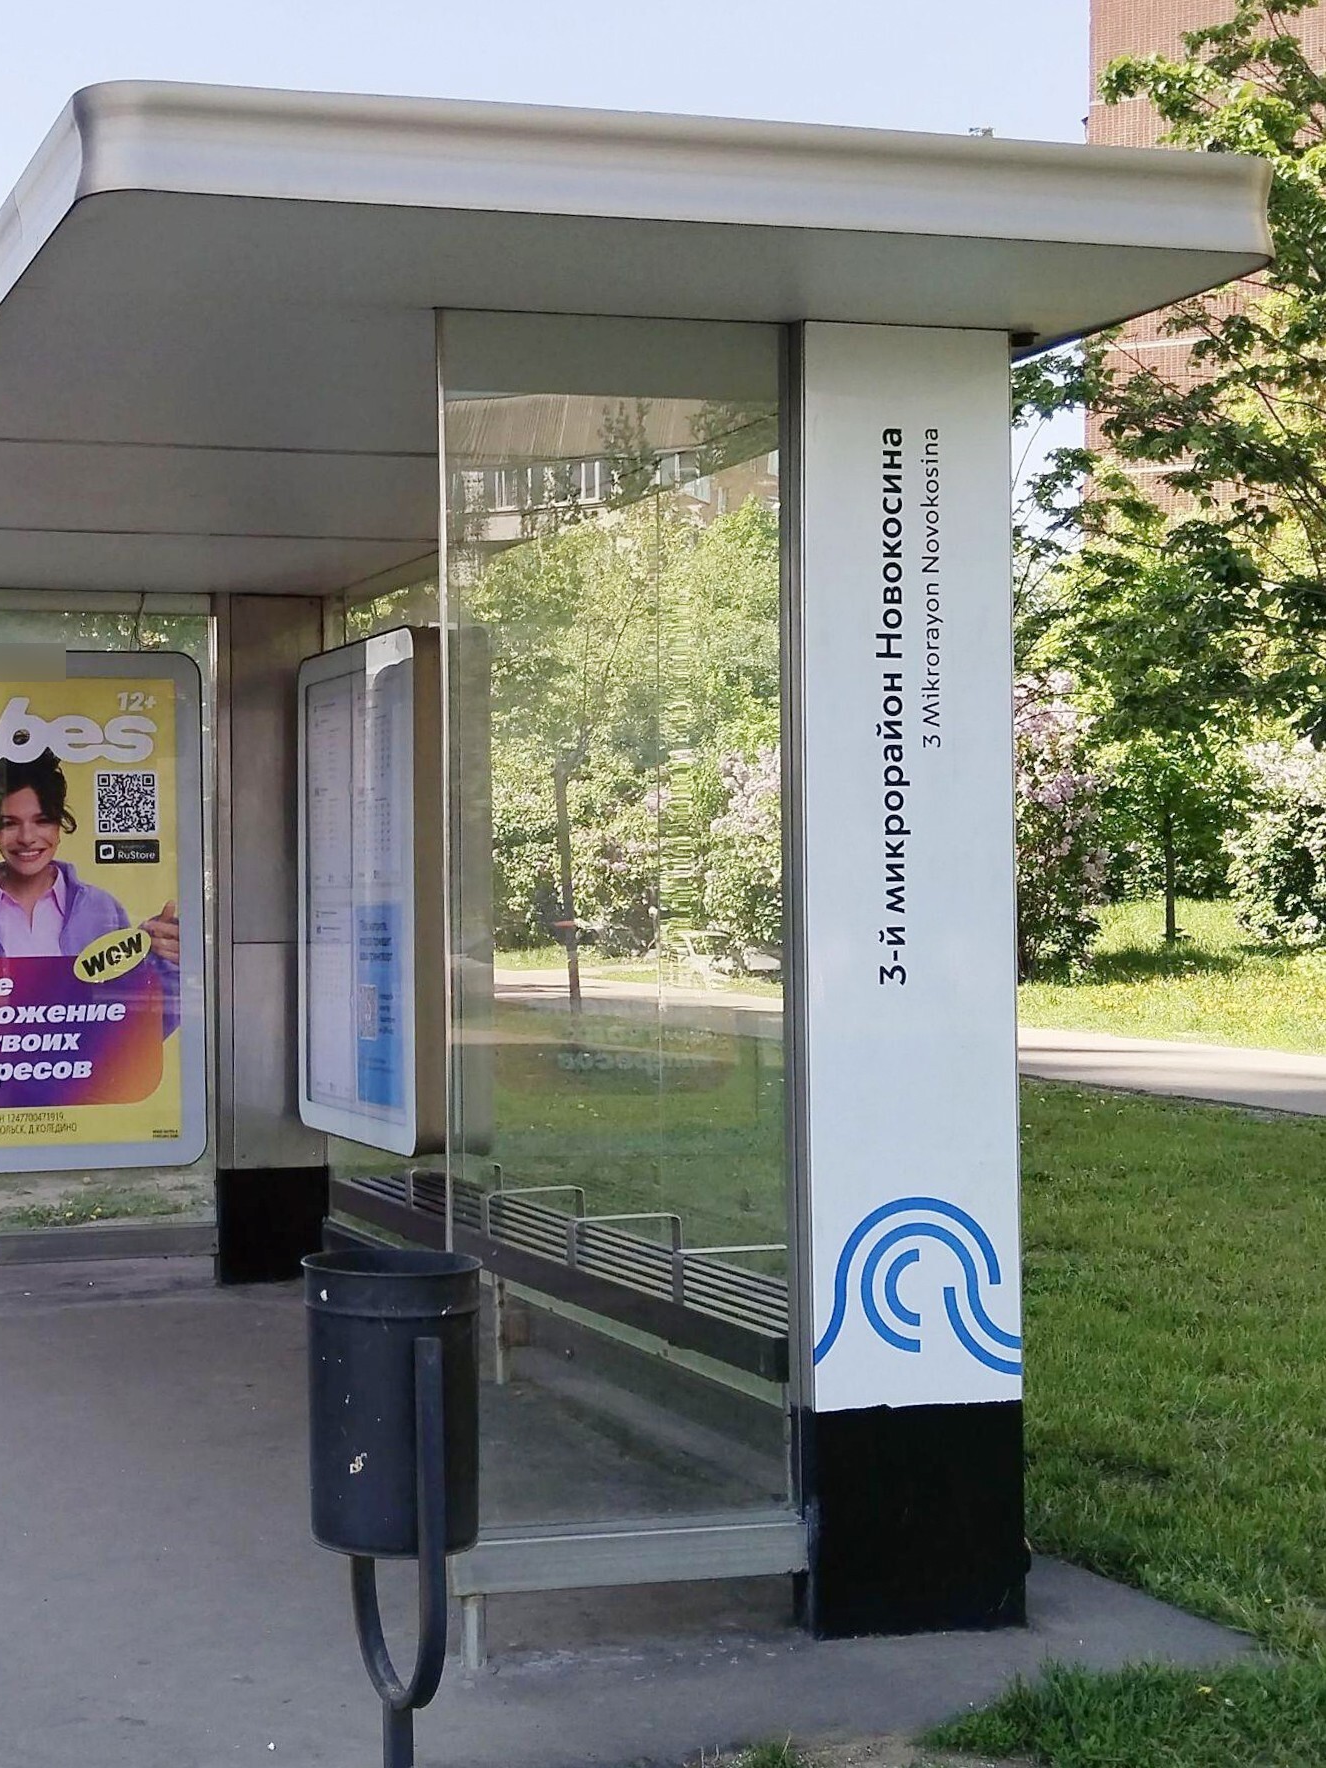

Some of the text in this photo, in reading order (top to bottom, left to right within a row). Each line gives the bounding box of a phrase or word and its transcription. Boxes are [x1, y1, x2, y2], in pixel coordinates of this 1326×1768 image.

[920, 428, 944, 749] 3 Mikrorayon Novokosina
[116, 691, 157, 711] 12+
[876, 427, 911, 986] 3-й микрорайон Новокосина
[117, 850, 156, 860] RuStore
